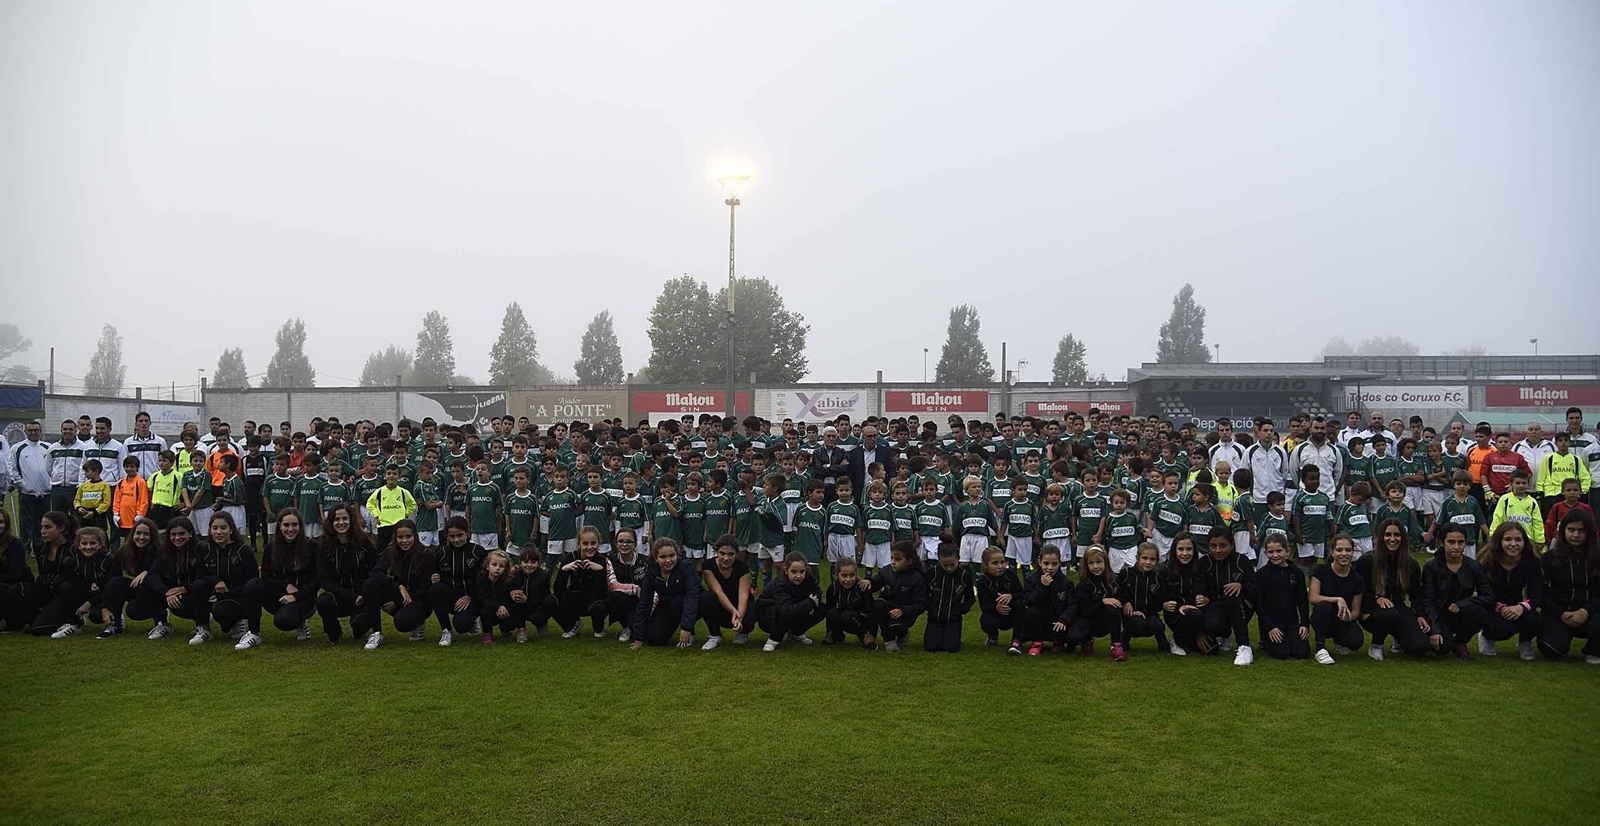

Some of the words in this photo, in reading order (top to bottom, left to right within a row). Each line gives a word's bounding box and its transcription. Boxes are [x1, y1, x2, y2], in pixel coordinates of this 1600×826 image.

[1349, 392, 1381, 402] Todos
[1385, 394, 1398, 402] co
[1401, 392, 1440, 402] Coruxo
[1443, 392, 1464, 402] F.C.
[1519, 386, 1568, 400] Mahou
[558, 395, 582, 404] Asador
[666, 393, 715, 406] Mahou
[911, 392, 962, 405] Mahou
[795, 392, 857, 419] Xabier
[1038, 402, 1068, 411] Mahou
[1090, 402, 1121, 411] Mahou
[1191, 416, 1254, 430] Depació
[1081, 509, 1101, 517] ABANC
[1305, 506, 1326, 514] ABANC
[1009, 515, 1031, 524] ABANC
[1190, 525, 1211, 534] ABANC
